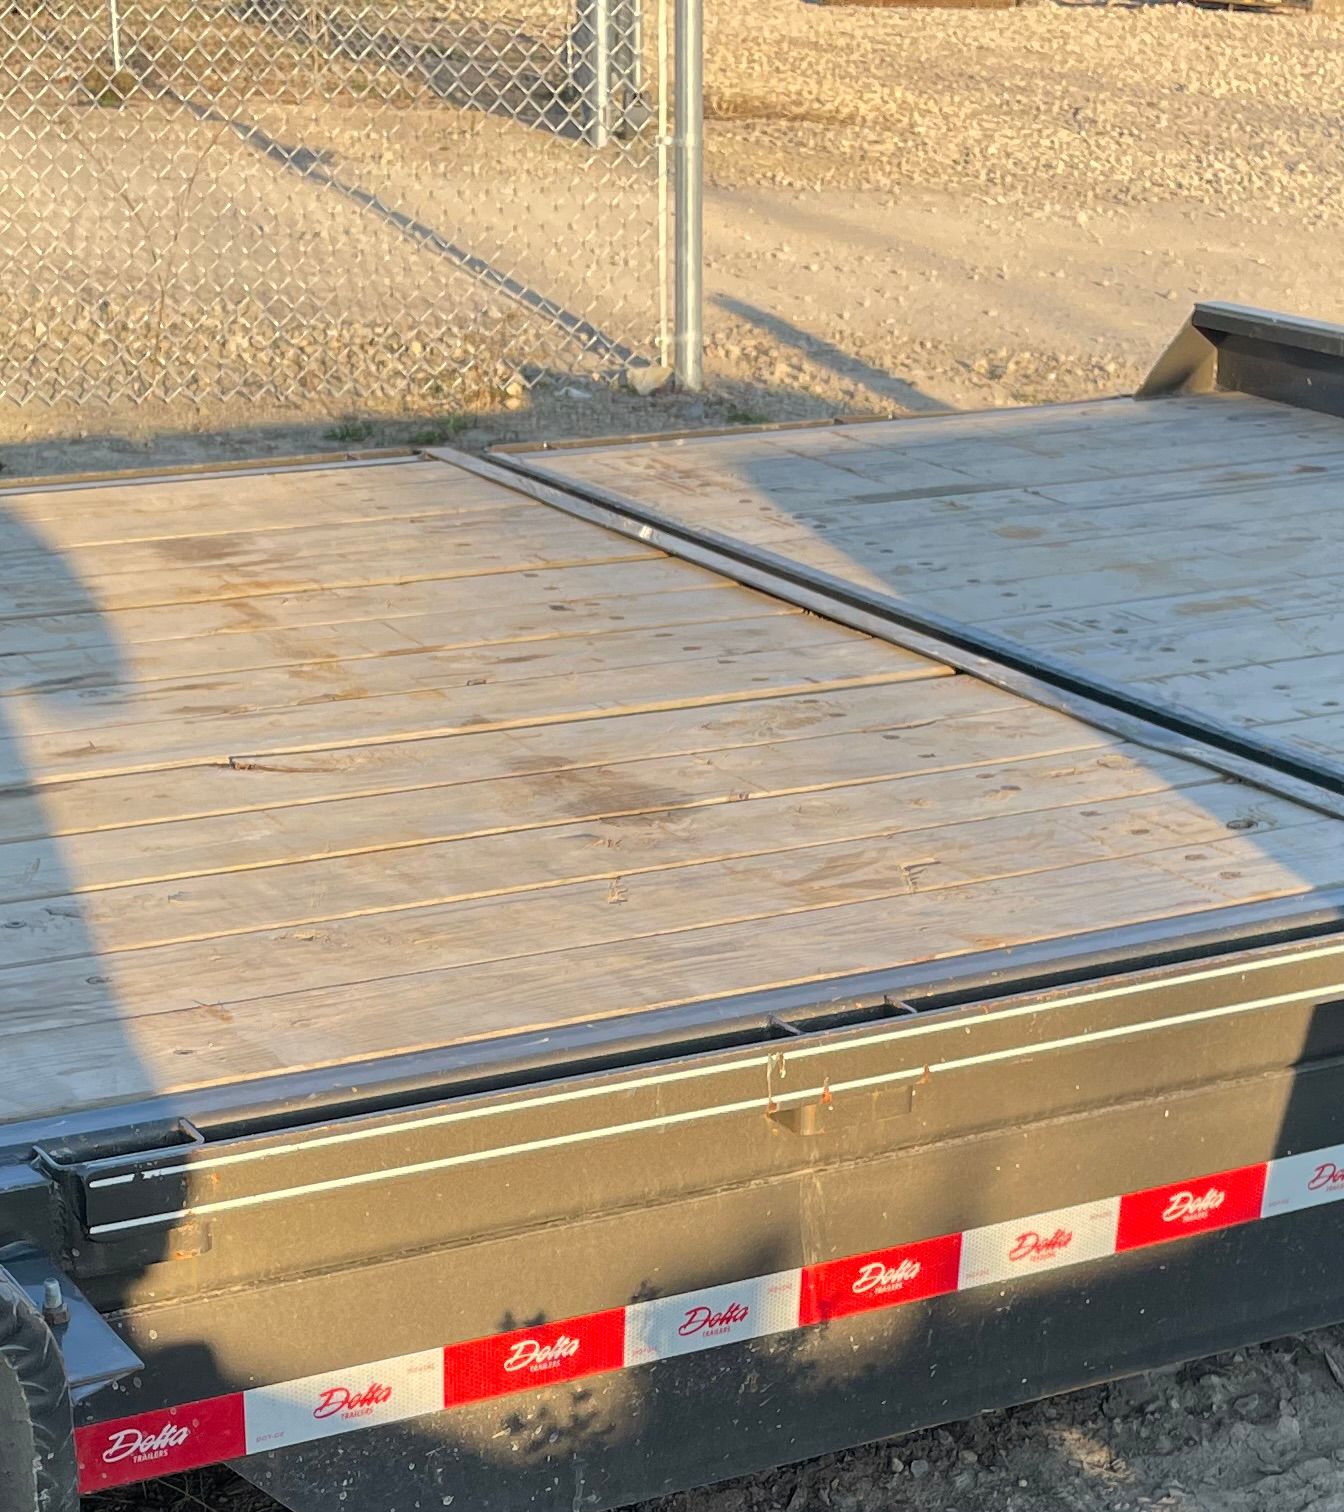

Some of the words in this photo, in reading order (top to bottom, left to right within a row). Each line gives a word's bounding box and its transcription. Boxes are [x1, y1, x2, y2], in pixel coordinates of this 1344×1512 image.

[852, 1258, 922, 1294] Delta
[678, 1302, 749, 1336] Delta
[504, 1335, 580, 1372] Delta
[313, 1382, 392, 1419] Delta
[341, 1407, 373, 1420] TRAILERS
[103, 1422, 191, 1463] Delta
[133, 1450, 169, 1464] TRAILERS
